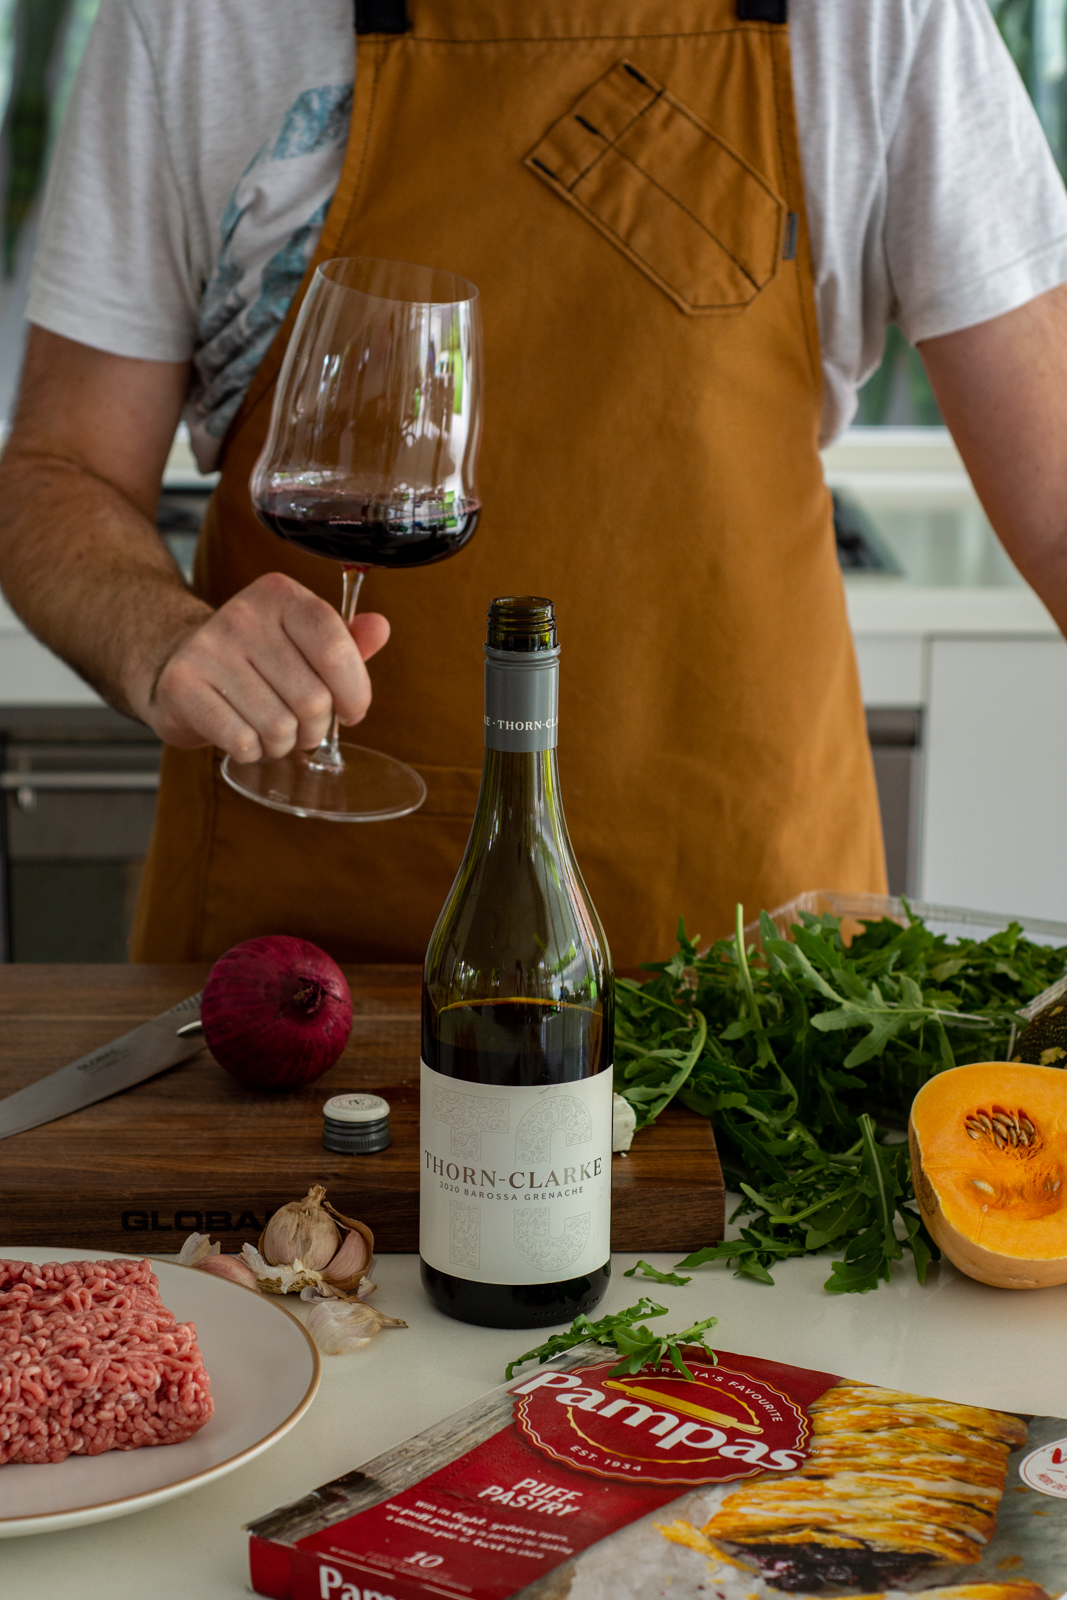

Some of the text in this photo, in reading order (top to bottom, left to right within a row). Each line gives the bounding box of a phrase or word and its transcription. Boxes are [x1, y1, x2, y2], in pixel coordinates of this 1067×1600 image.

[424, 1149, 603, 1190] THORN-CLARKE
[439, 1180, 585, 1202] 2020 BAROSSA GRENACHE
[121, 1210, 276, 1232] GLOBA
[728, 1381, 784, 1423] FAVOURITE
[513, 1371, 808, 1472] Pampas
[569, 1445, 642, 1472] EST. 1934
[477, 1485, 581, 1517] PASTRY
[512, 1477, 584, 1502] PUFF
[399, 1508, 433, 1522] puff
[428, 1517, 477, 1536] pastry
[403, 1551, 445, 1569] 10
